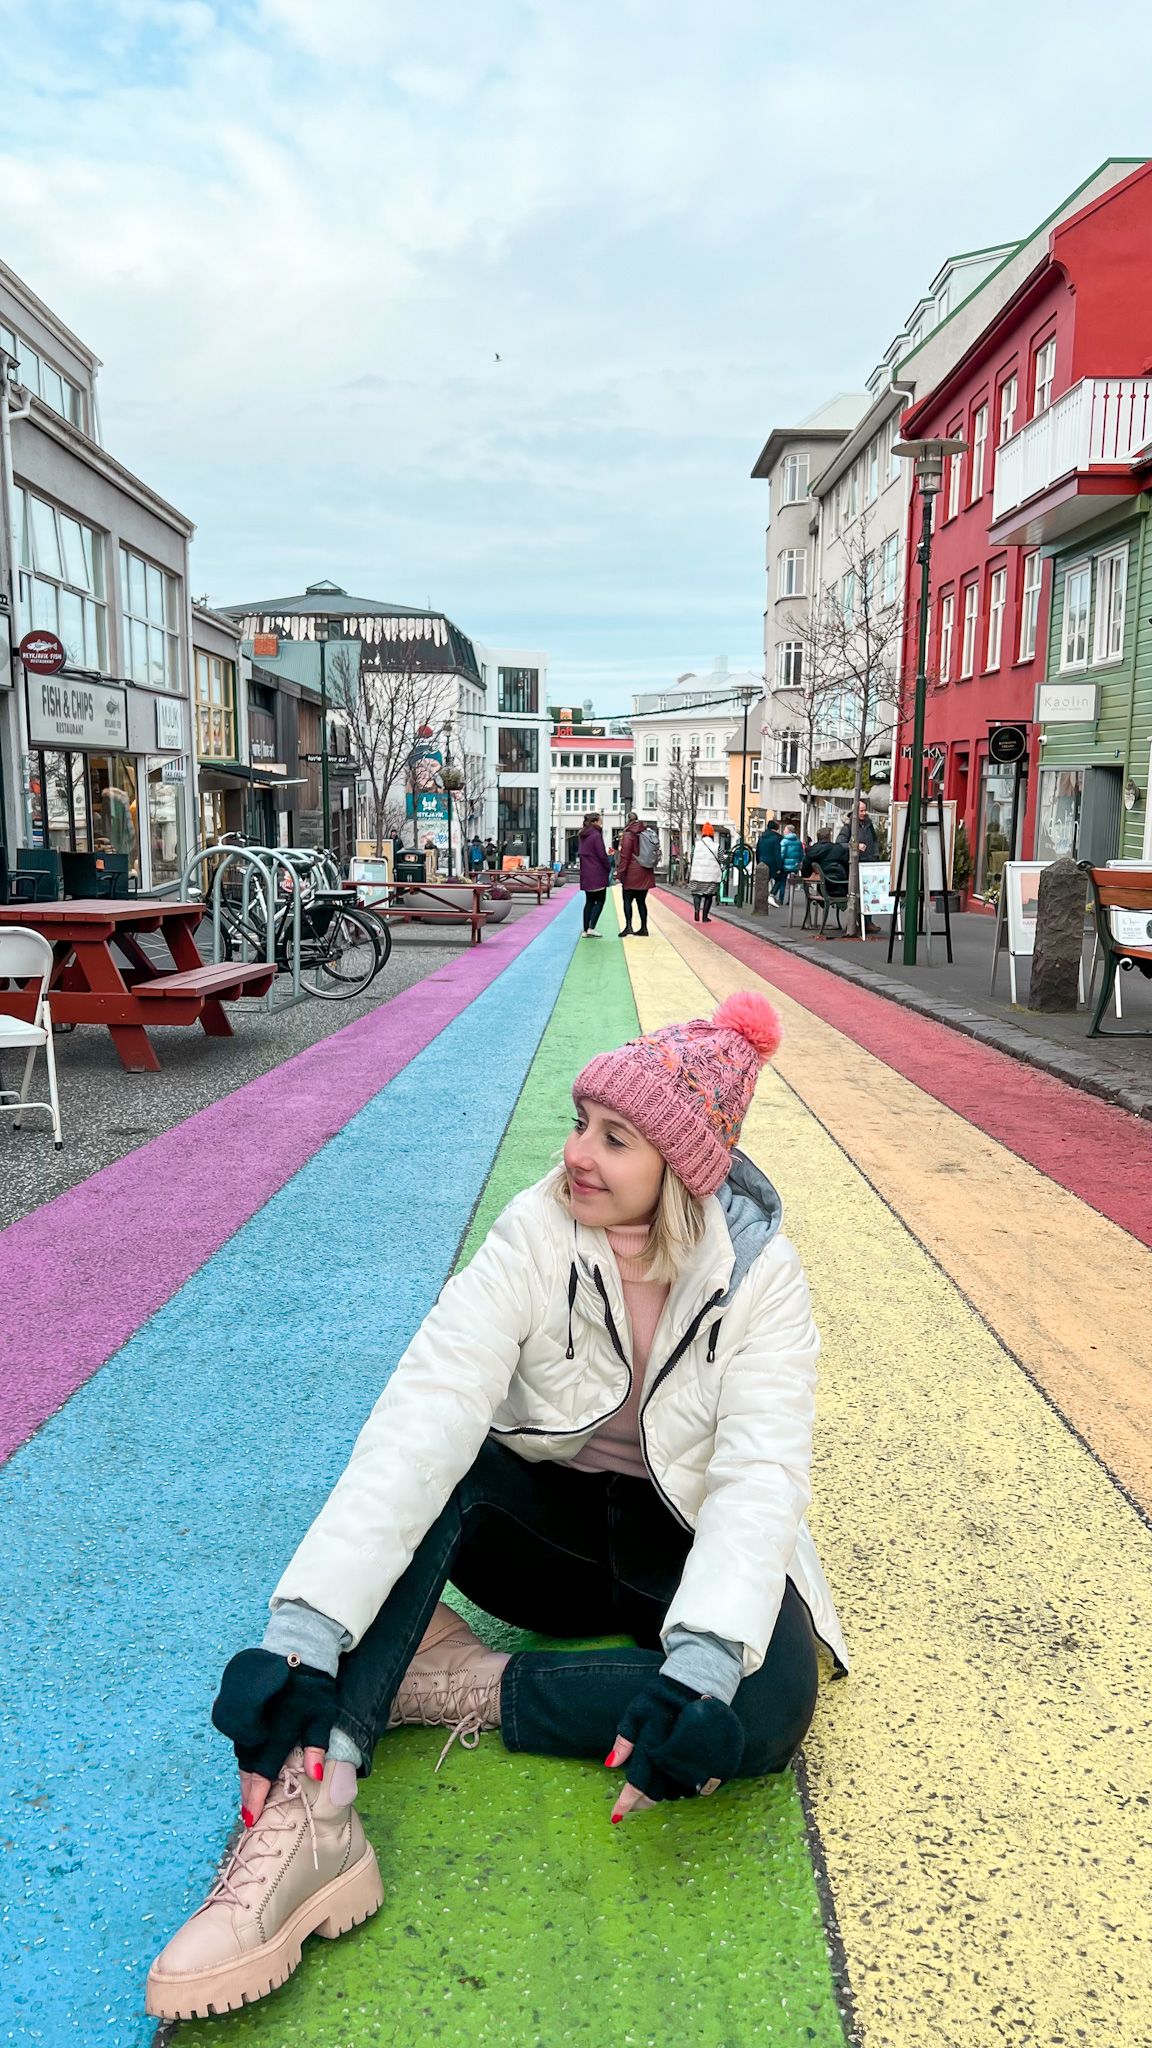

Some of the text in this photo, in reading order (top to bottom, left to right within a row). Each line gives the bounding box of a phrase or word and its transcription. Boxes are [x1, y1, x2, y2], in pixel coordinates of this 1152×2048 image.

[41, 684, 94, 722] FISH & CHIPS
[1044, 696, 1089, 708] Kaolin
[56, 721, 84, 736] RESTAURANT
